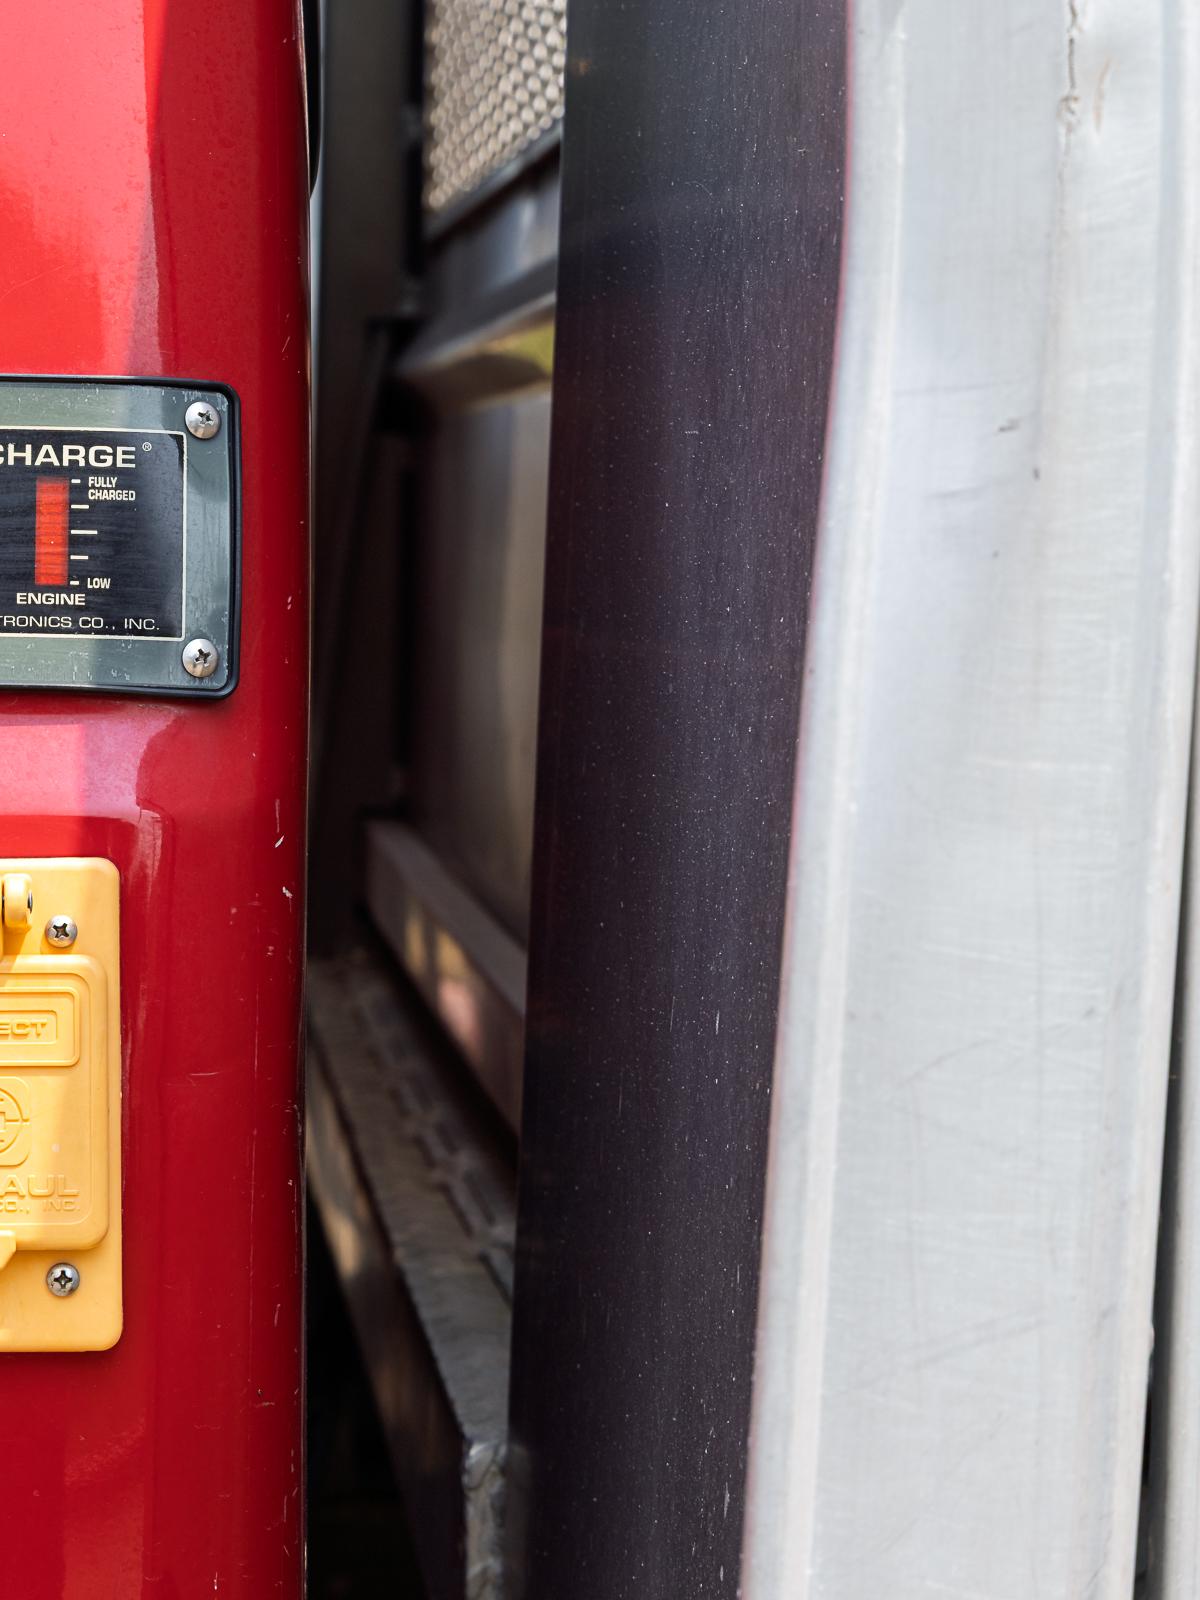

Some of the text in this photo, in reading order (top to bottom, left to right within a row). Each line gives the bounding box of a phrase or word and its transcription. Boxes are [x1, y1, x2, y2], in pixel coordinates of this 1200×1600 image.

[88, 476, 118, 488] FULLY
[88, 489, 136, 501] CHARGED
[87, 577, 111, 589] LOW
[16, 592, 86, 606] ENGINE
[124, 618, 160, 630] INC.
